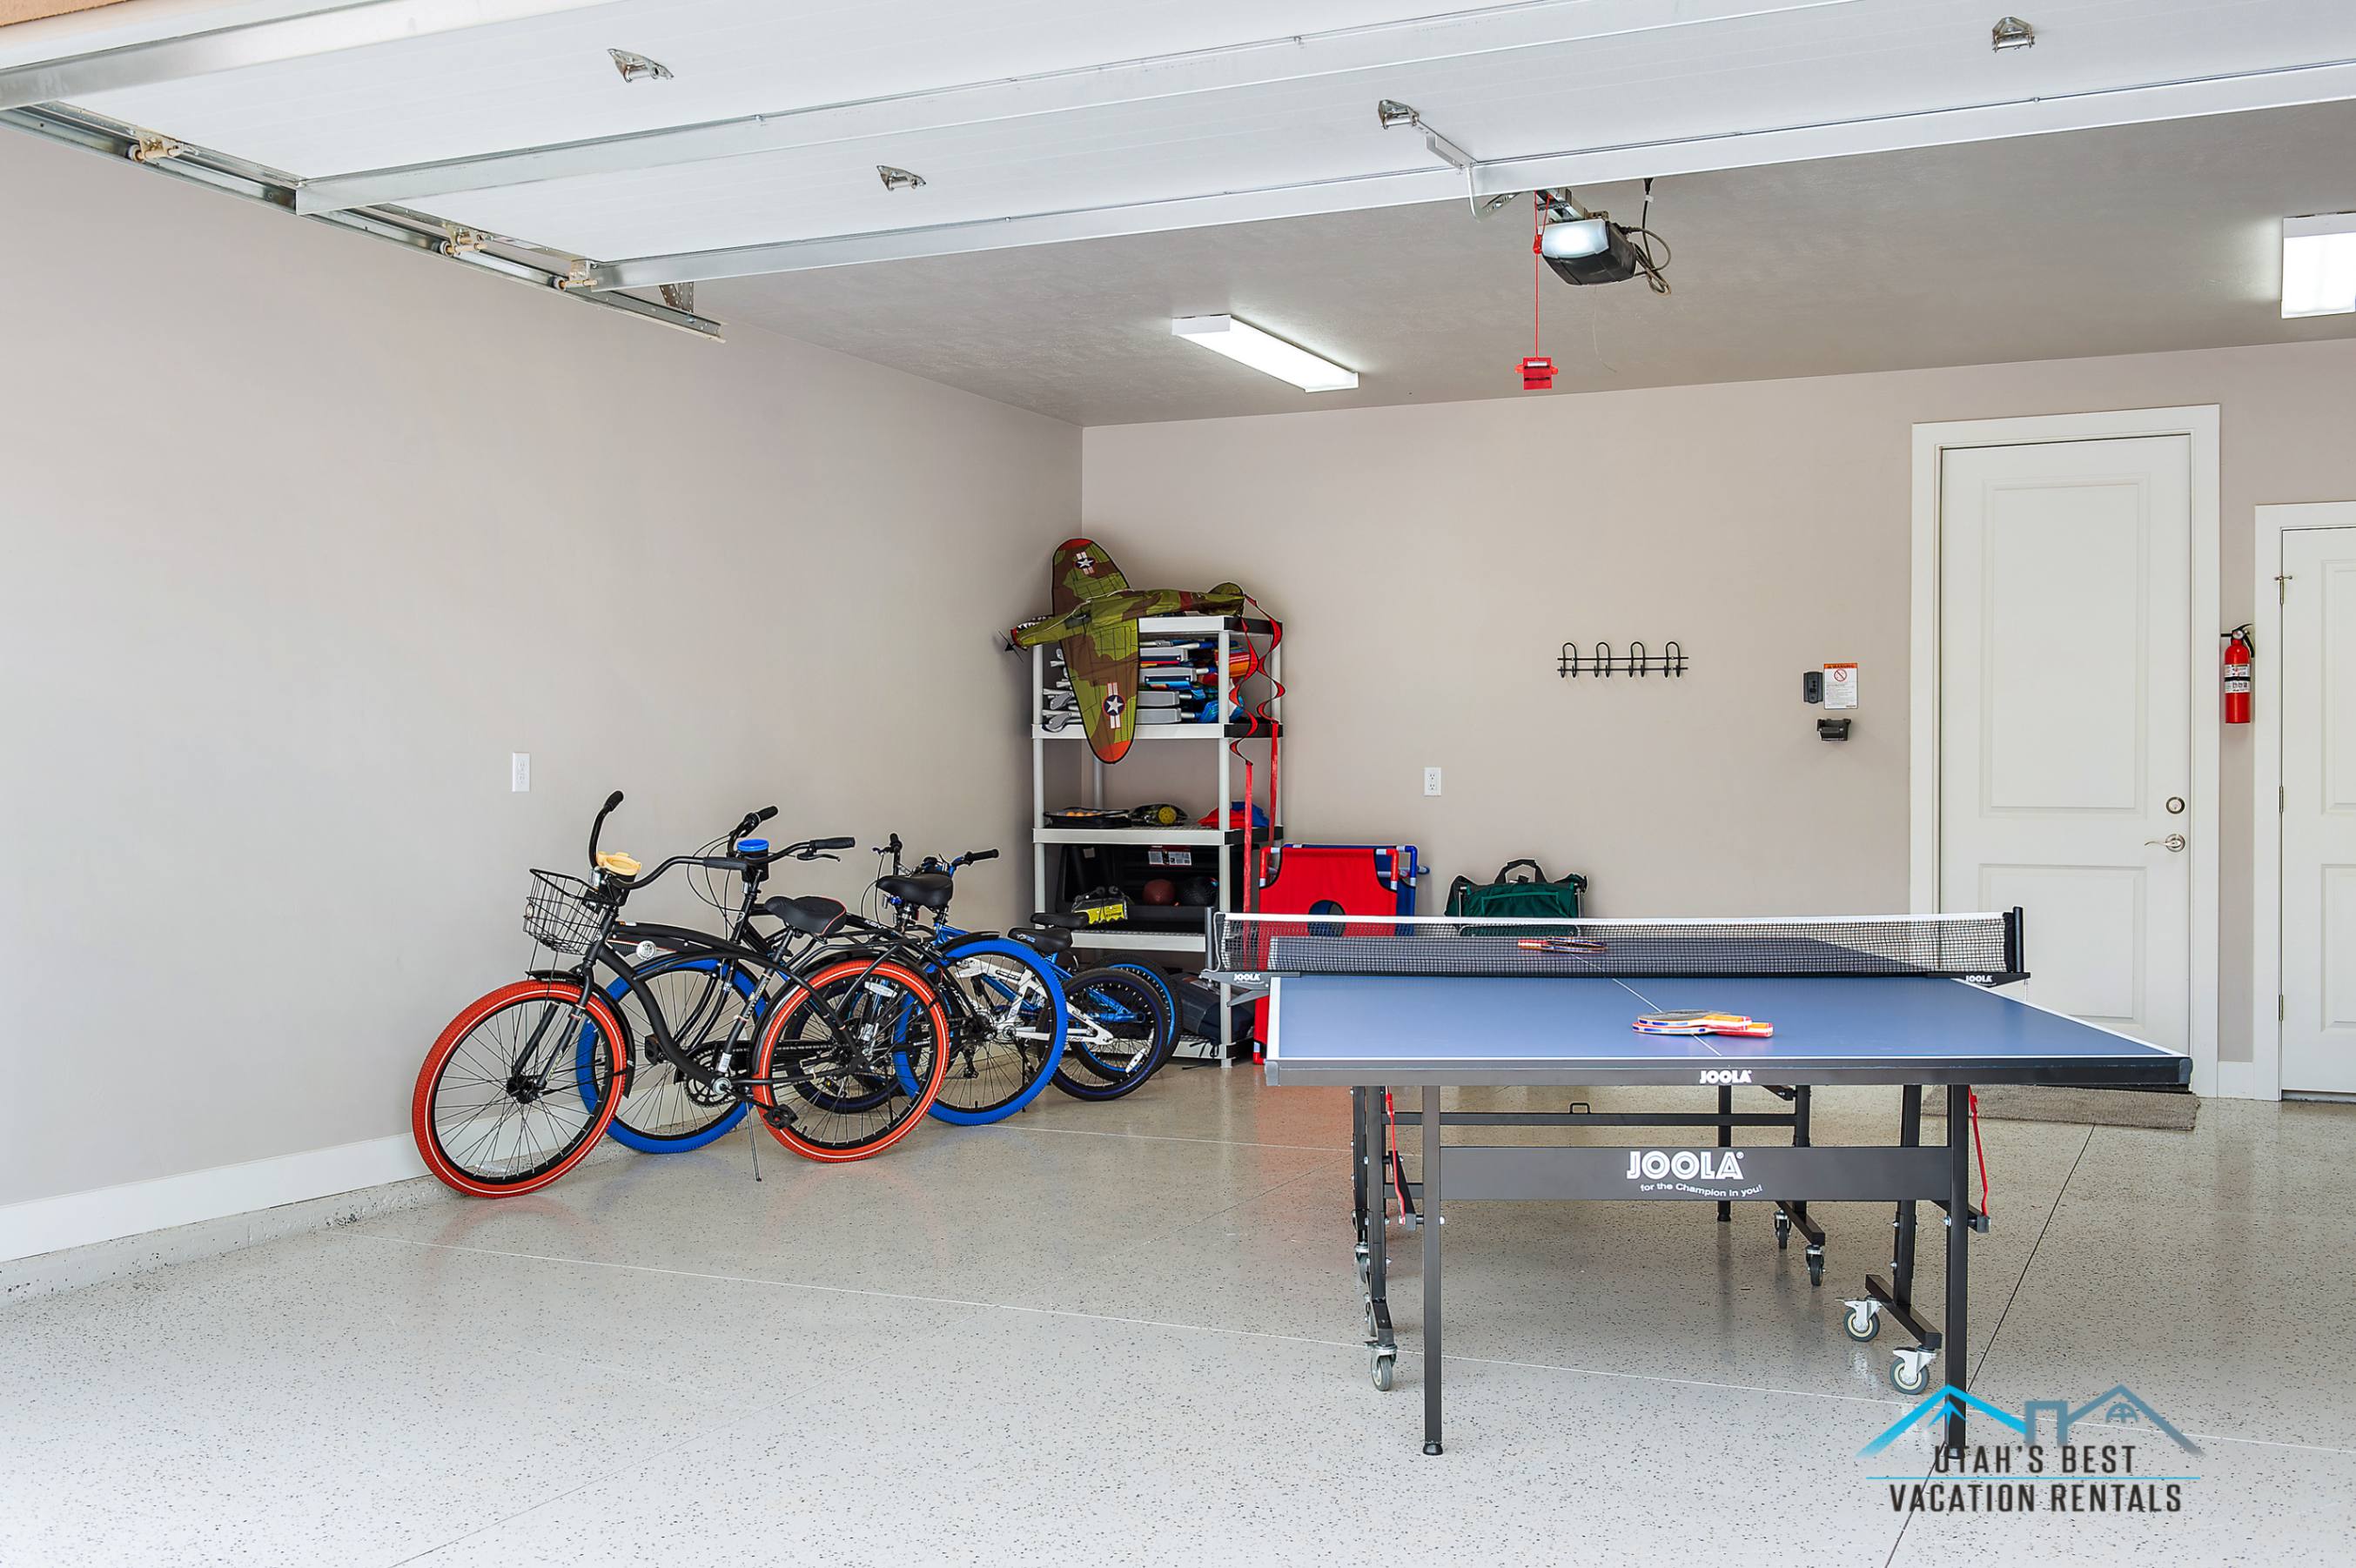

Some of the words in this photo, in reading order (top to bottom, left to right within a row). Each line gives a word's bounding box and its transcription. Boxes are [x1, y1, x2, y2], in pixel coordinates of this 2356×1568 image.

[1700, 1069, 1752, 1084] JOOLA
[1641, 1183, 1655, 1192] for
[1675, 1183, 1727, 1197] Champion
[1728, 1188, 1739, 1197] in
[1741, 1183, 1762, 1198] you!
